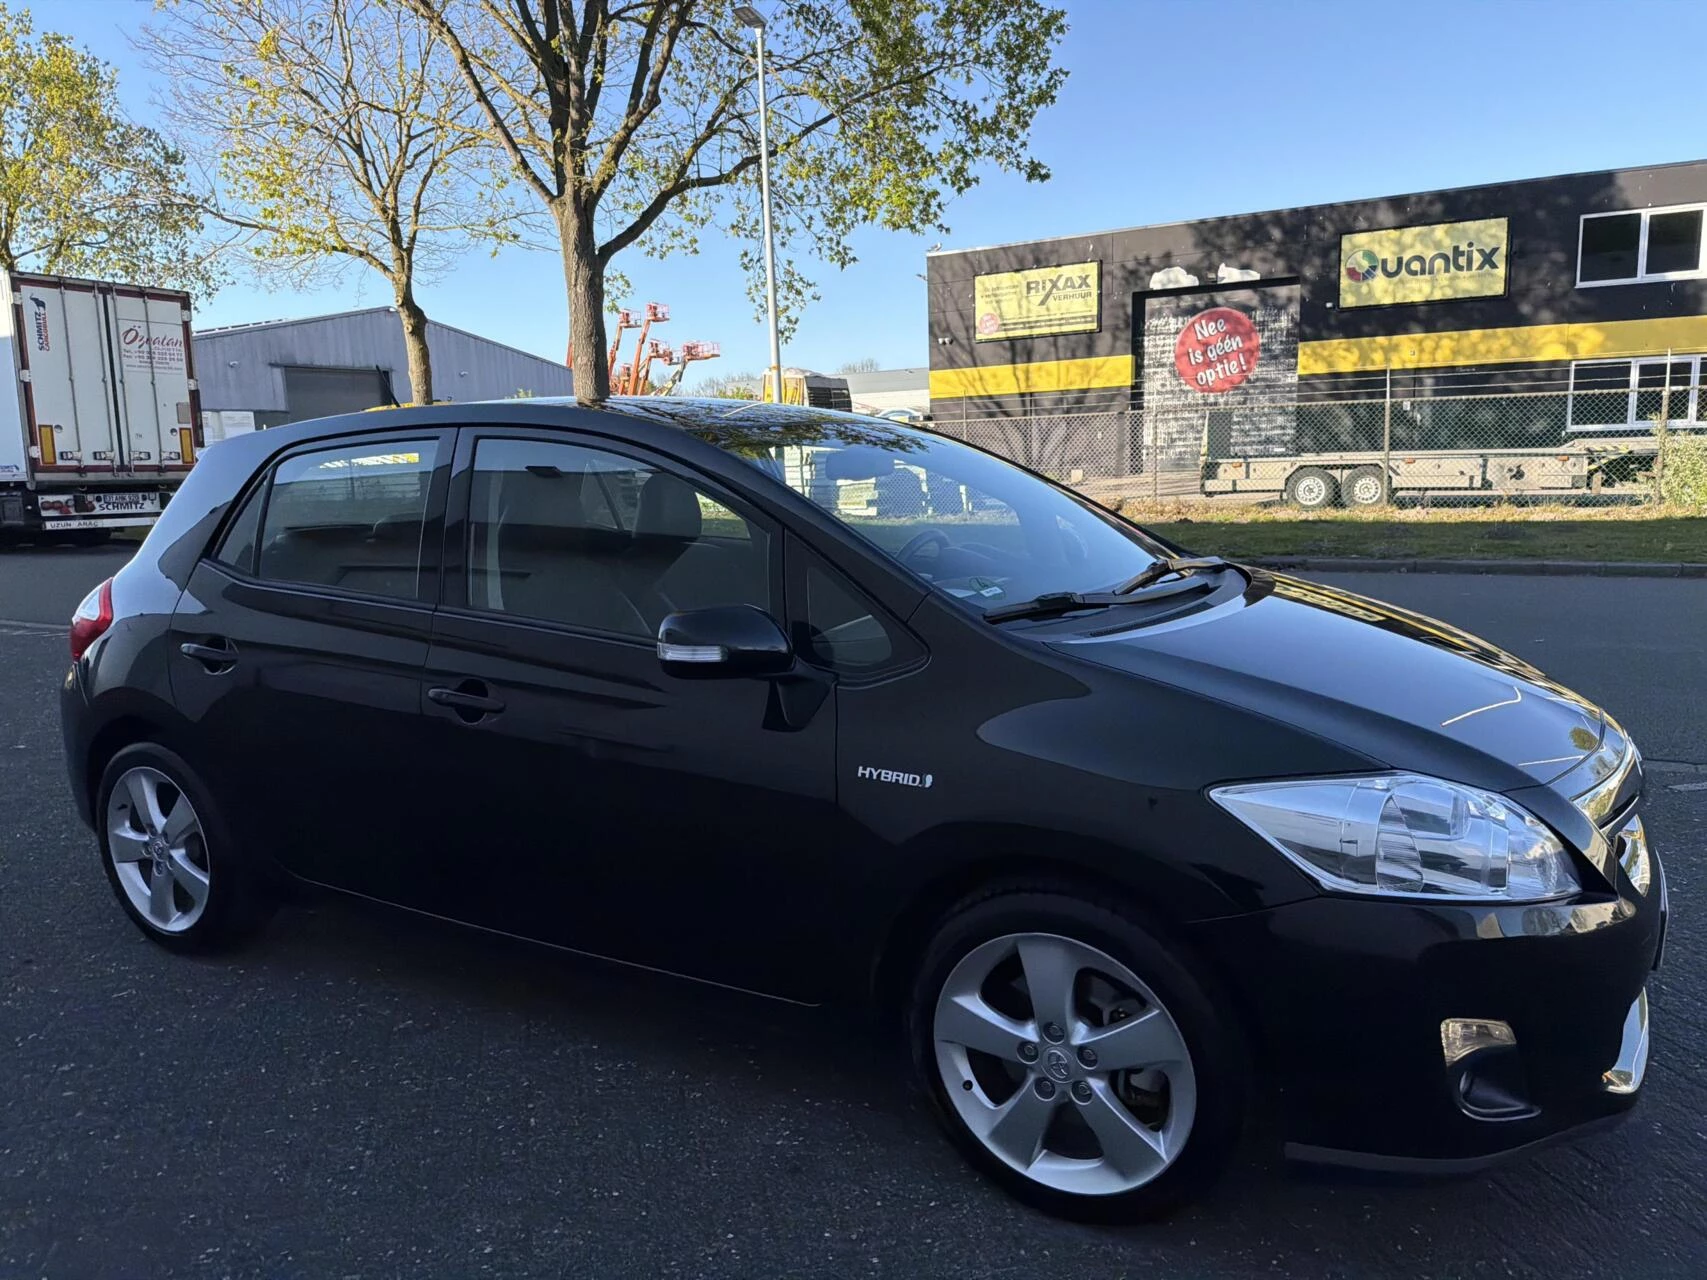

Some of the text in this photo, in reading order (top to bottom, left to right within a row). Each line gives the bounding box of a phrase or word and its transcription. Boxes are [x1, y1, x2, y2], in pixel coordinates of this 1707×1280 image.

[1052, 291, 1092, 301] VERHUUR
[34, 311, 44, 350] SCHMITZ
[1194, 318, 1227, 340] Nee
[1188, 334, 1243, 365] is géén
[99, 502, 145, 511] SCHMITZ
[857, 765, 921, 787] HYBRID
